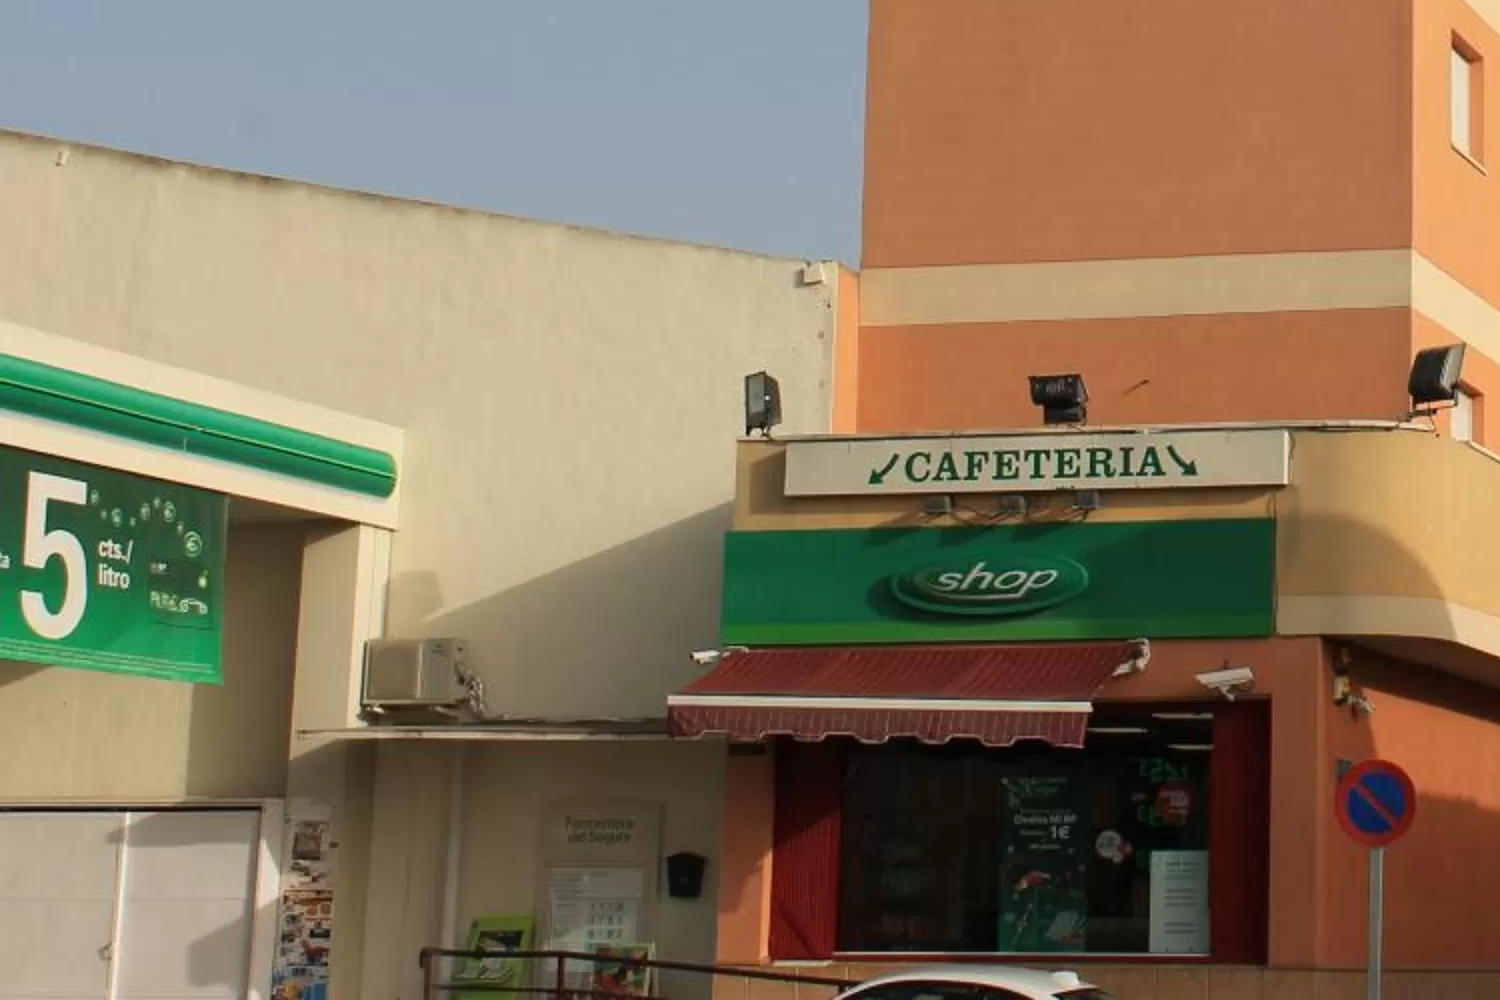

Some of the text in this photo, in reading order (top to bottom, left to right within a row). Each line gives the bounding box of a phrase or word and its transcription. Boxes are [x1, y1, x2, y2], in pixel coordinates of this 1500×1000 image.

[904, 446, 1166, 483] CAFETERIA
[20, 470, 88, 640] 5
[98, 538, 134, 564] cts./
[98, 563, 131, 589] litro
[936, 562, 1059, 597] shop
